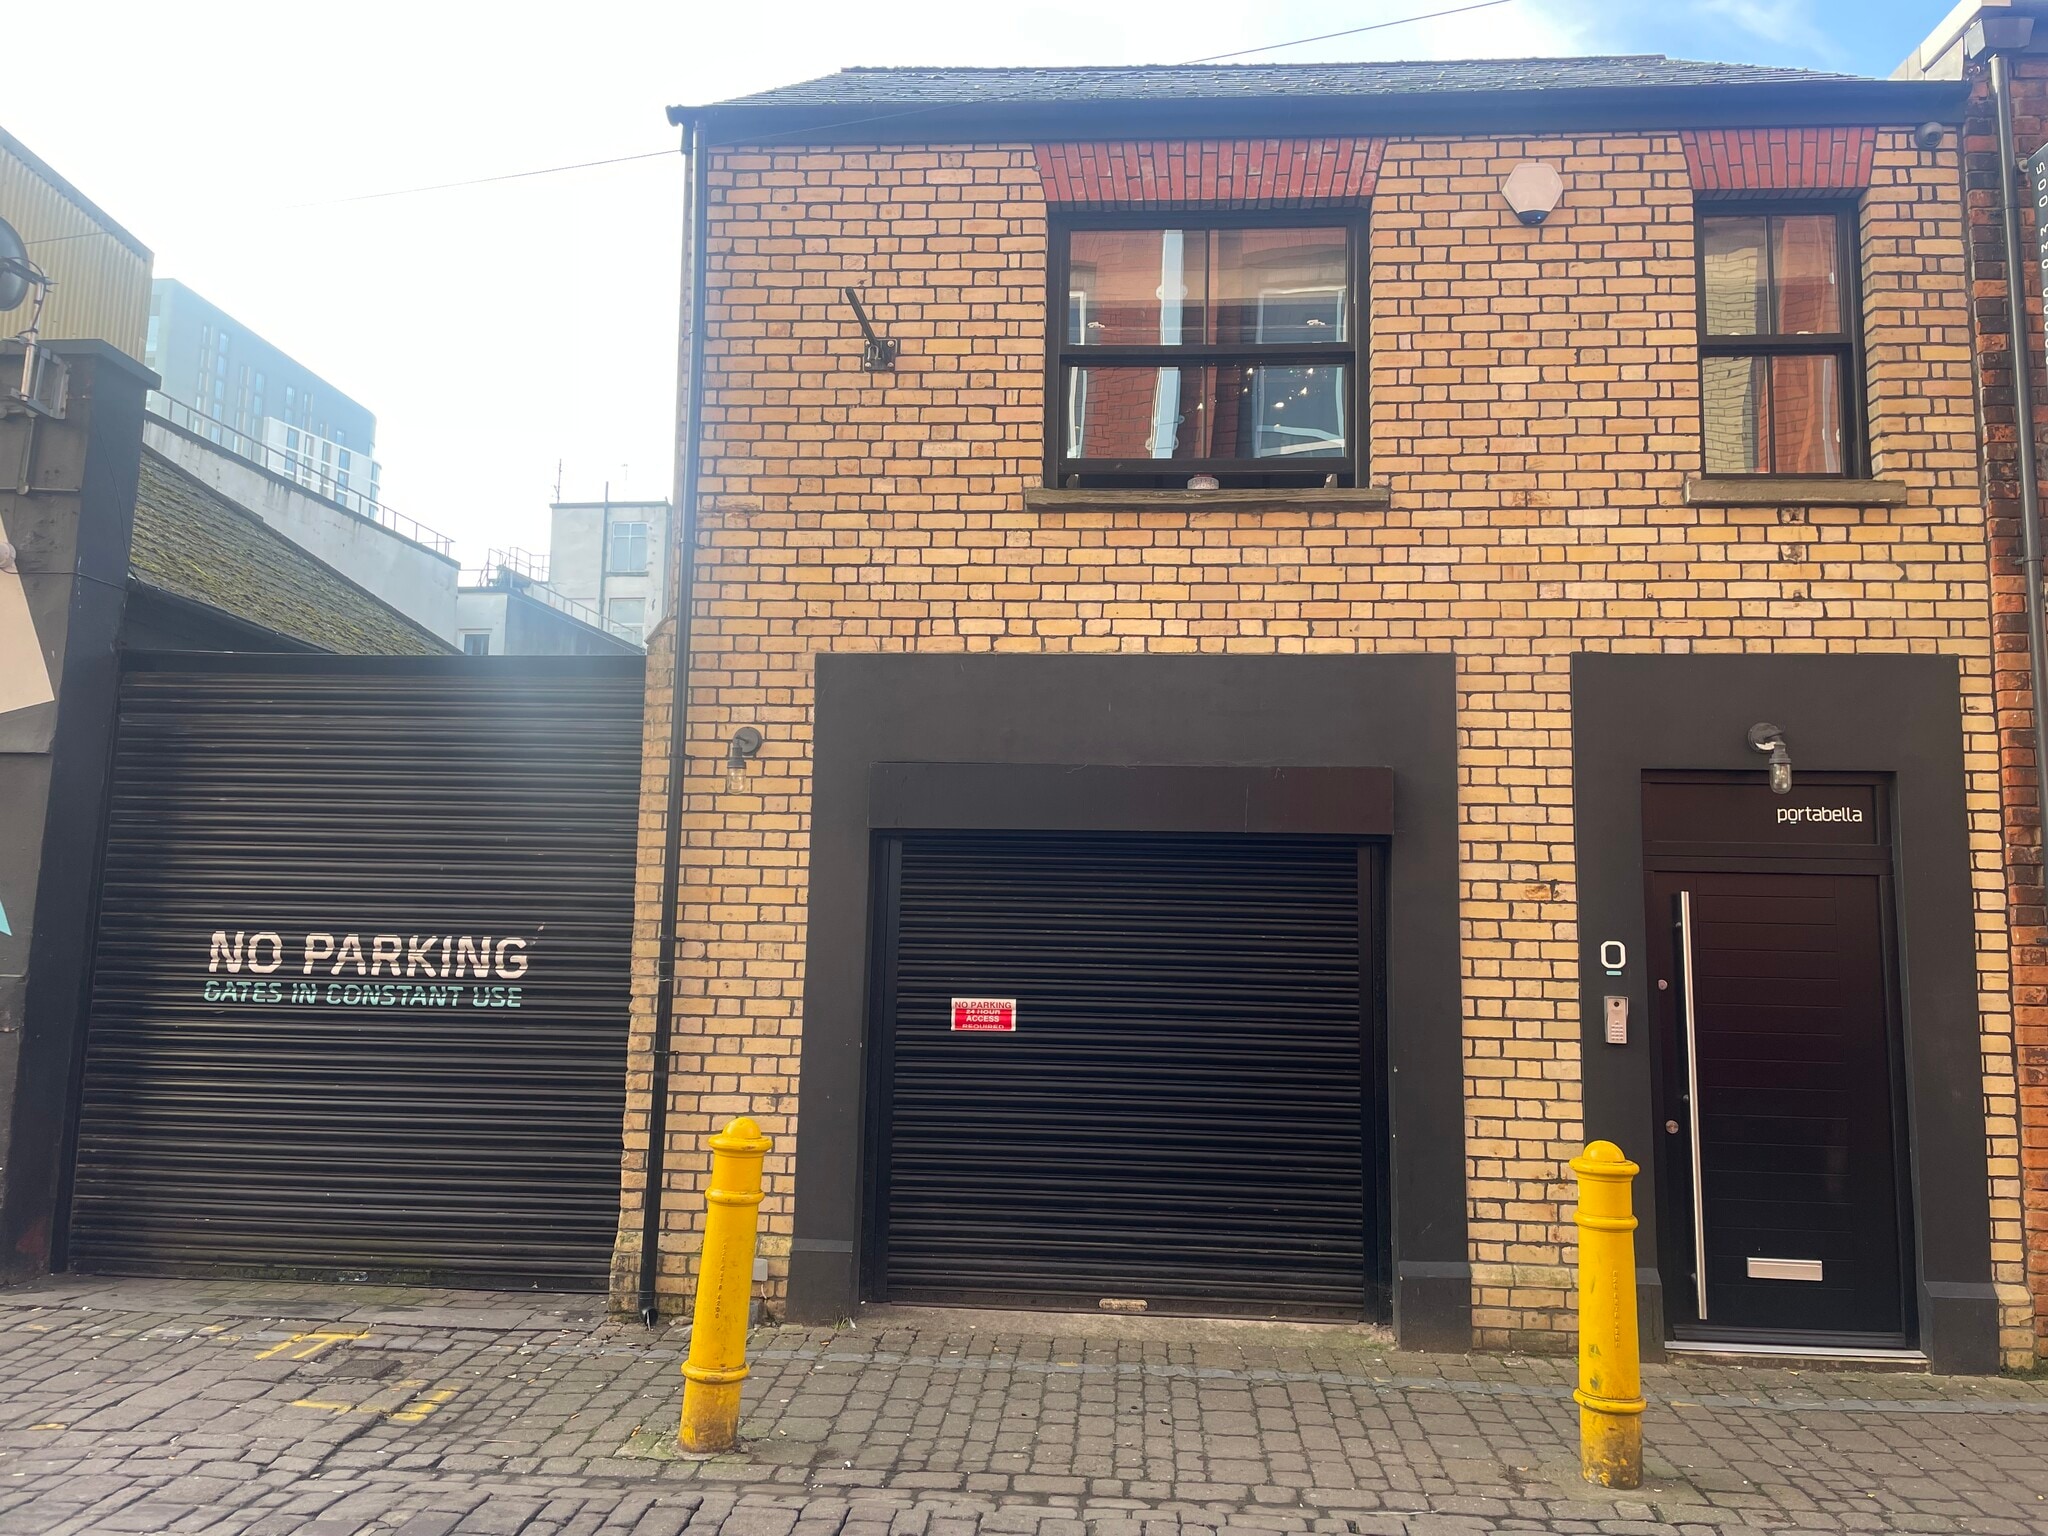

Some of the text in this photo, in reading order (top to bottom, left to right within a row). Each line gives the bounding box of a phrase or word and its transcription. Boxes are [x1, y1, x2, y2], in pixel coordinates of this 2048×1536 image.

[1777, 806, 1863, 824] portabella
[208, 930, 528, 979] NO PARKING
[203, 980, 523, 1008] GATES IN CONSTANT USE
[970, 1001, 1012, 1009] PARKING
